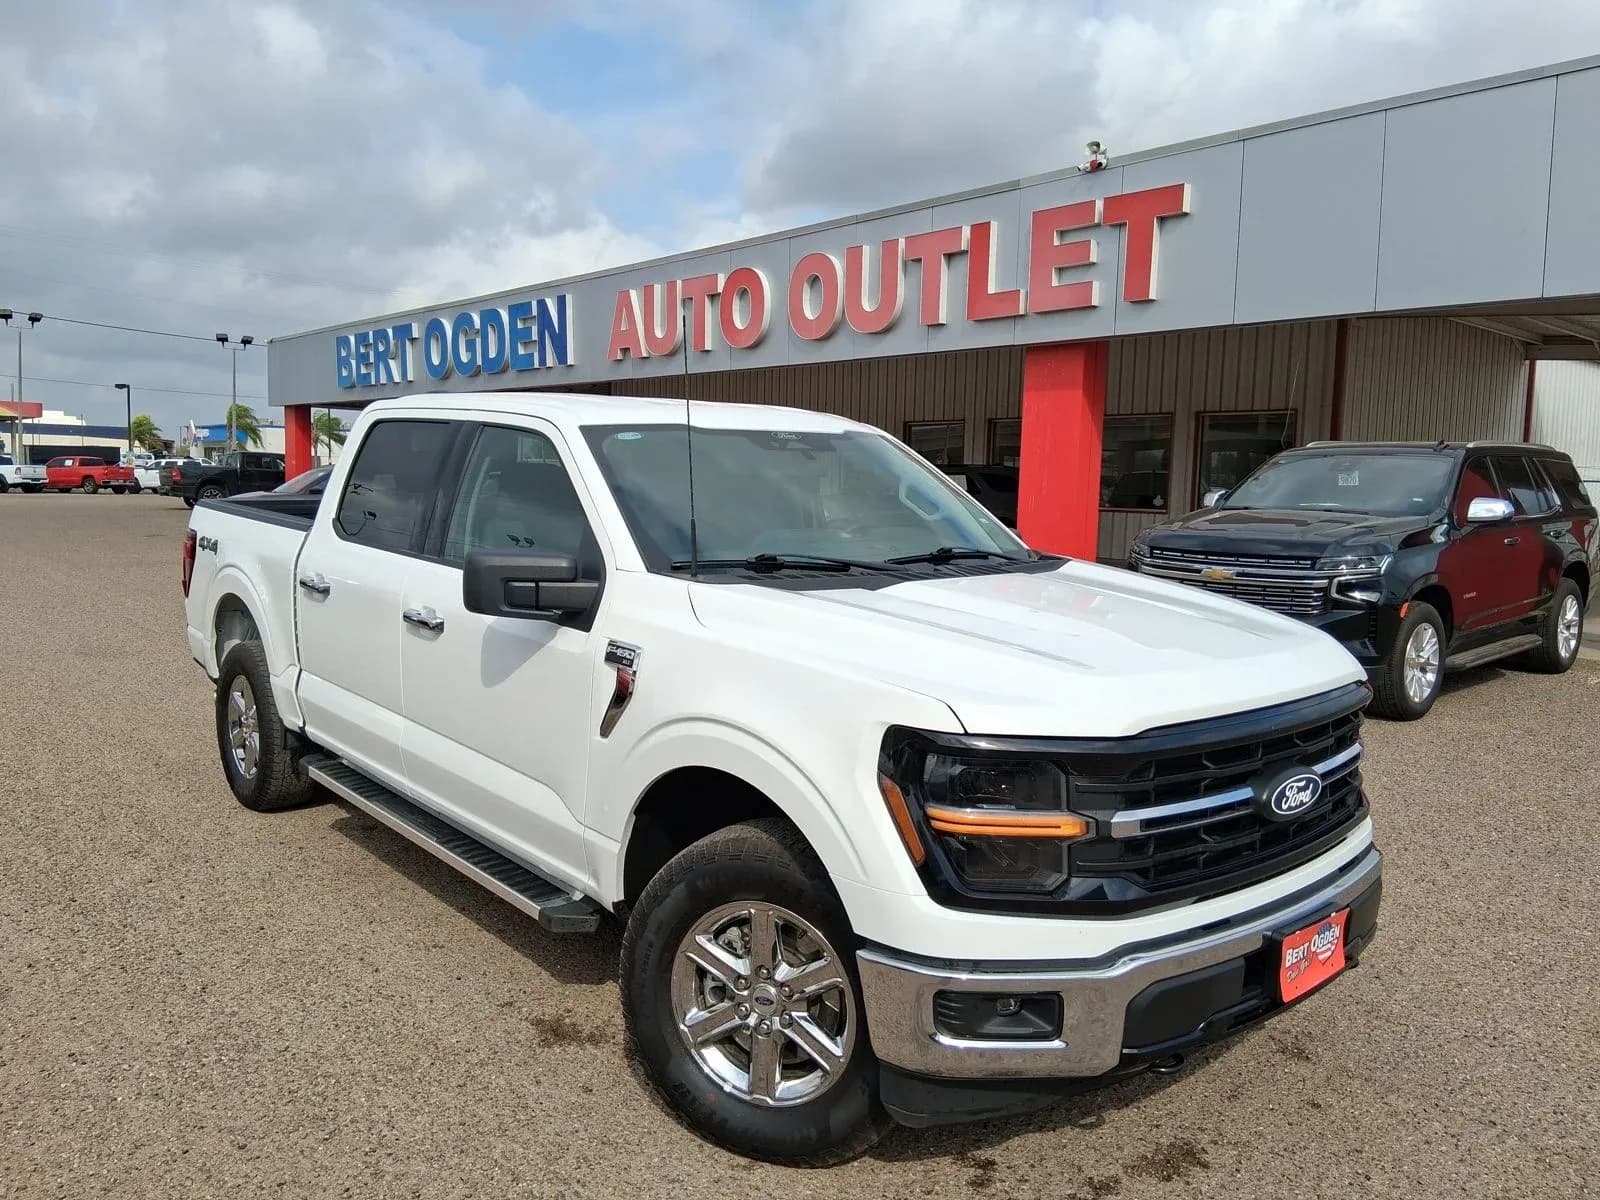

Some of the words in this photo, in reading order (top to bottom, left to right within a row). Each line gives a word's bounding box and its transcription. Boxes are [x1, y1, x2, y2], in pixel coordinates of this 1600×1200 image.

[336, 323, 418, 388] BERT
[424, 294, 574, 379] OGDEN
[608, 266, 771, 361] AUTO
[788, 183, 1191, 341] OUTLET
[607, 645, 635, 660] F-150
[1282, 780, 1313, 810] Ford
[1286, 941, 1310, 968] BERT
[1310, 924, 1341, 953] OGDEN
